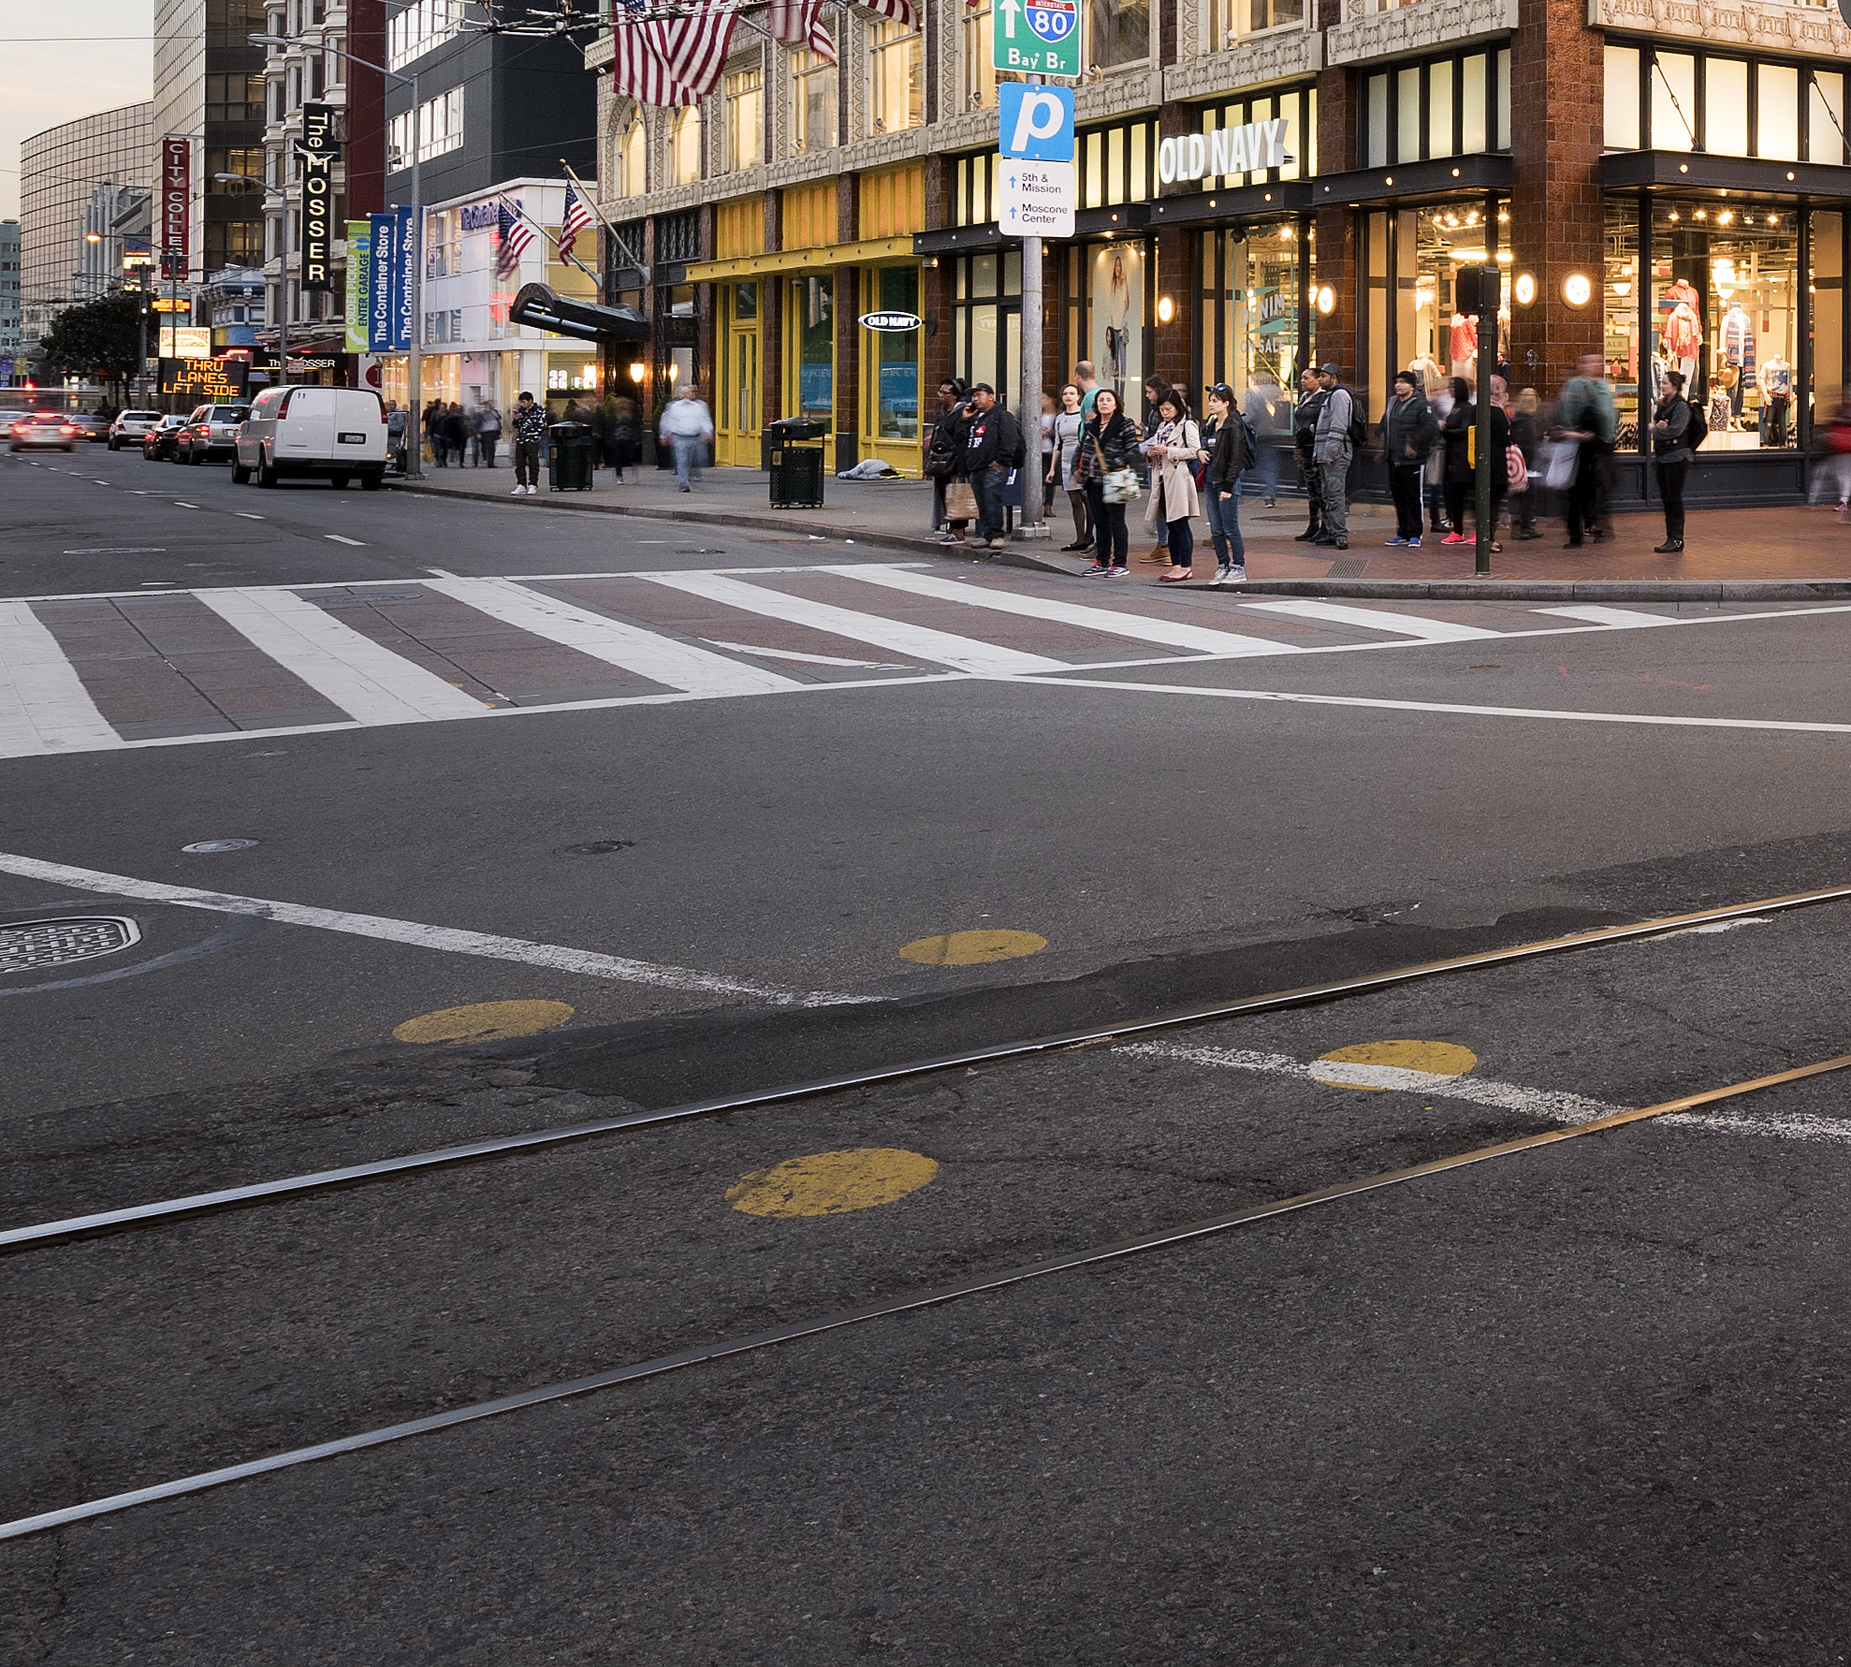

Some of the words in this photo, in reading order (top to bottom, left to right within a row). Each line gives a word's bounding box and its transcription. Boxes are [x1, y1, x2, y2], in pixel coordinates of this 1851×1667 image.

[1035, 0, 1066, 10] INTERSTATE
[1034, 11, 1067, 35] 80
[1008, 48, 1038, 69] Bay
[1046, 52, 1066, 69] Br
[308, 112, 328, 147] The
[1159, 133, 1208, 184] OLD
[1211, 118, 1286, 176] NAVY
[168, 144, 184, 187] CITY
[1022, 173, 1038, 182] 5th
[1041, 174, 1049, 183] &
[1022, 183, 1062, 194] Mission
[1022, 203, 1068, 214] Moscone
[1022, 214, 1057, 224] Center
[376, 225, 389, 259] Store
[346, 254, 357, 289] PICKUP
[359, 253, 369, 294] GARAGE
[375, 259, 388, 320] Container
[400, 253, 412, 316] Container
[346, 292, 356, 326] ORDER
[358, 297, 368, 326] ENTER
[1240, 291, 1285, 328] DENIM
[374, 321, 387, 343] The
[401, 317, 411, 340] The
[868, 316, 888, 326] OLD
[889, 317, 916, 327] NAVY
[1240, 340, 1254, 353] ON
[1258, 339, 1285, 353] SALE
[184, 359, 224, 372] THRU
[177, 371, 228, 384] LANES
[549, 369, 568, 388] 22
[163, 382, 194, 394] LFT
[203, 384, 240, 396] SIDE
